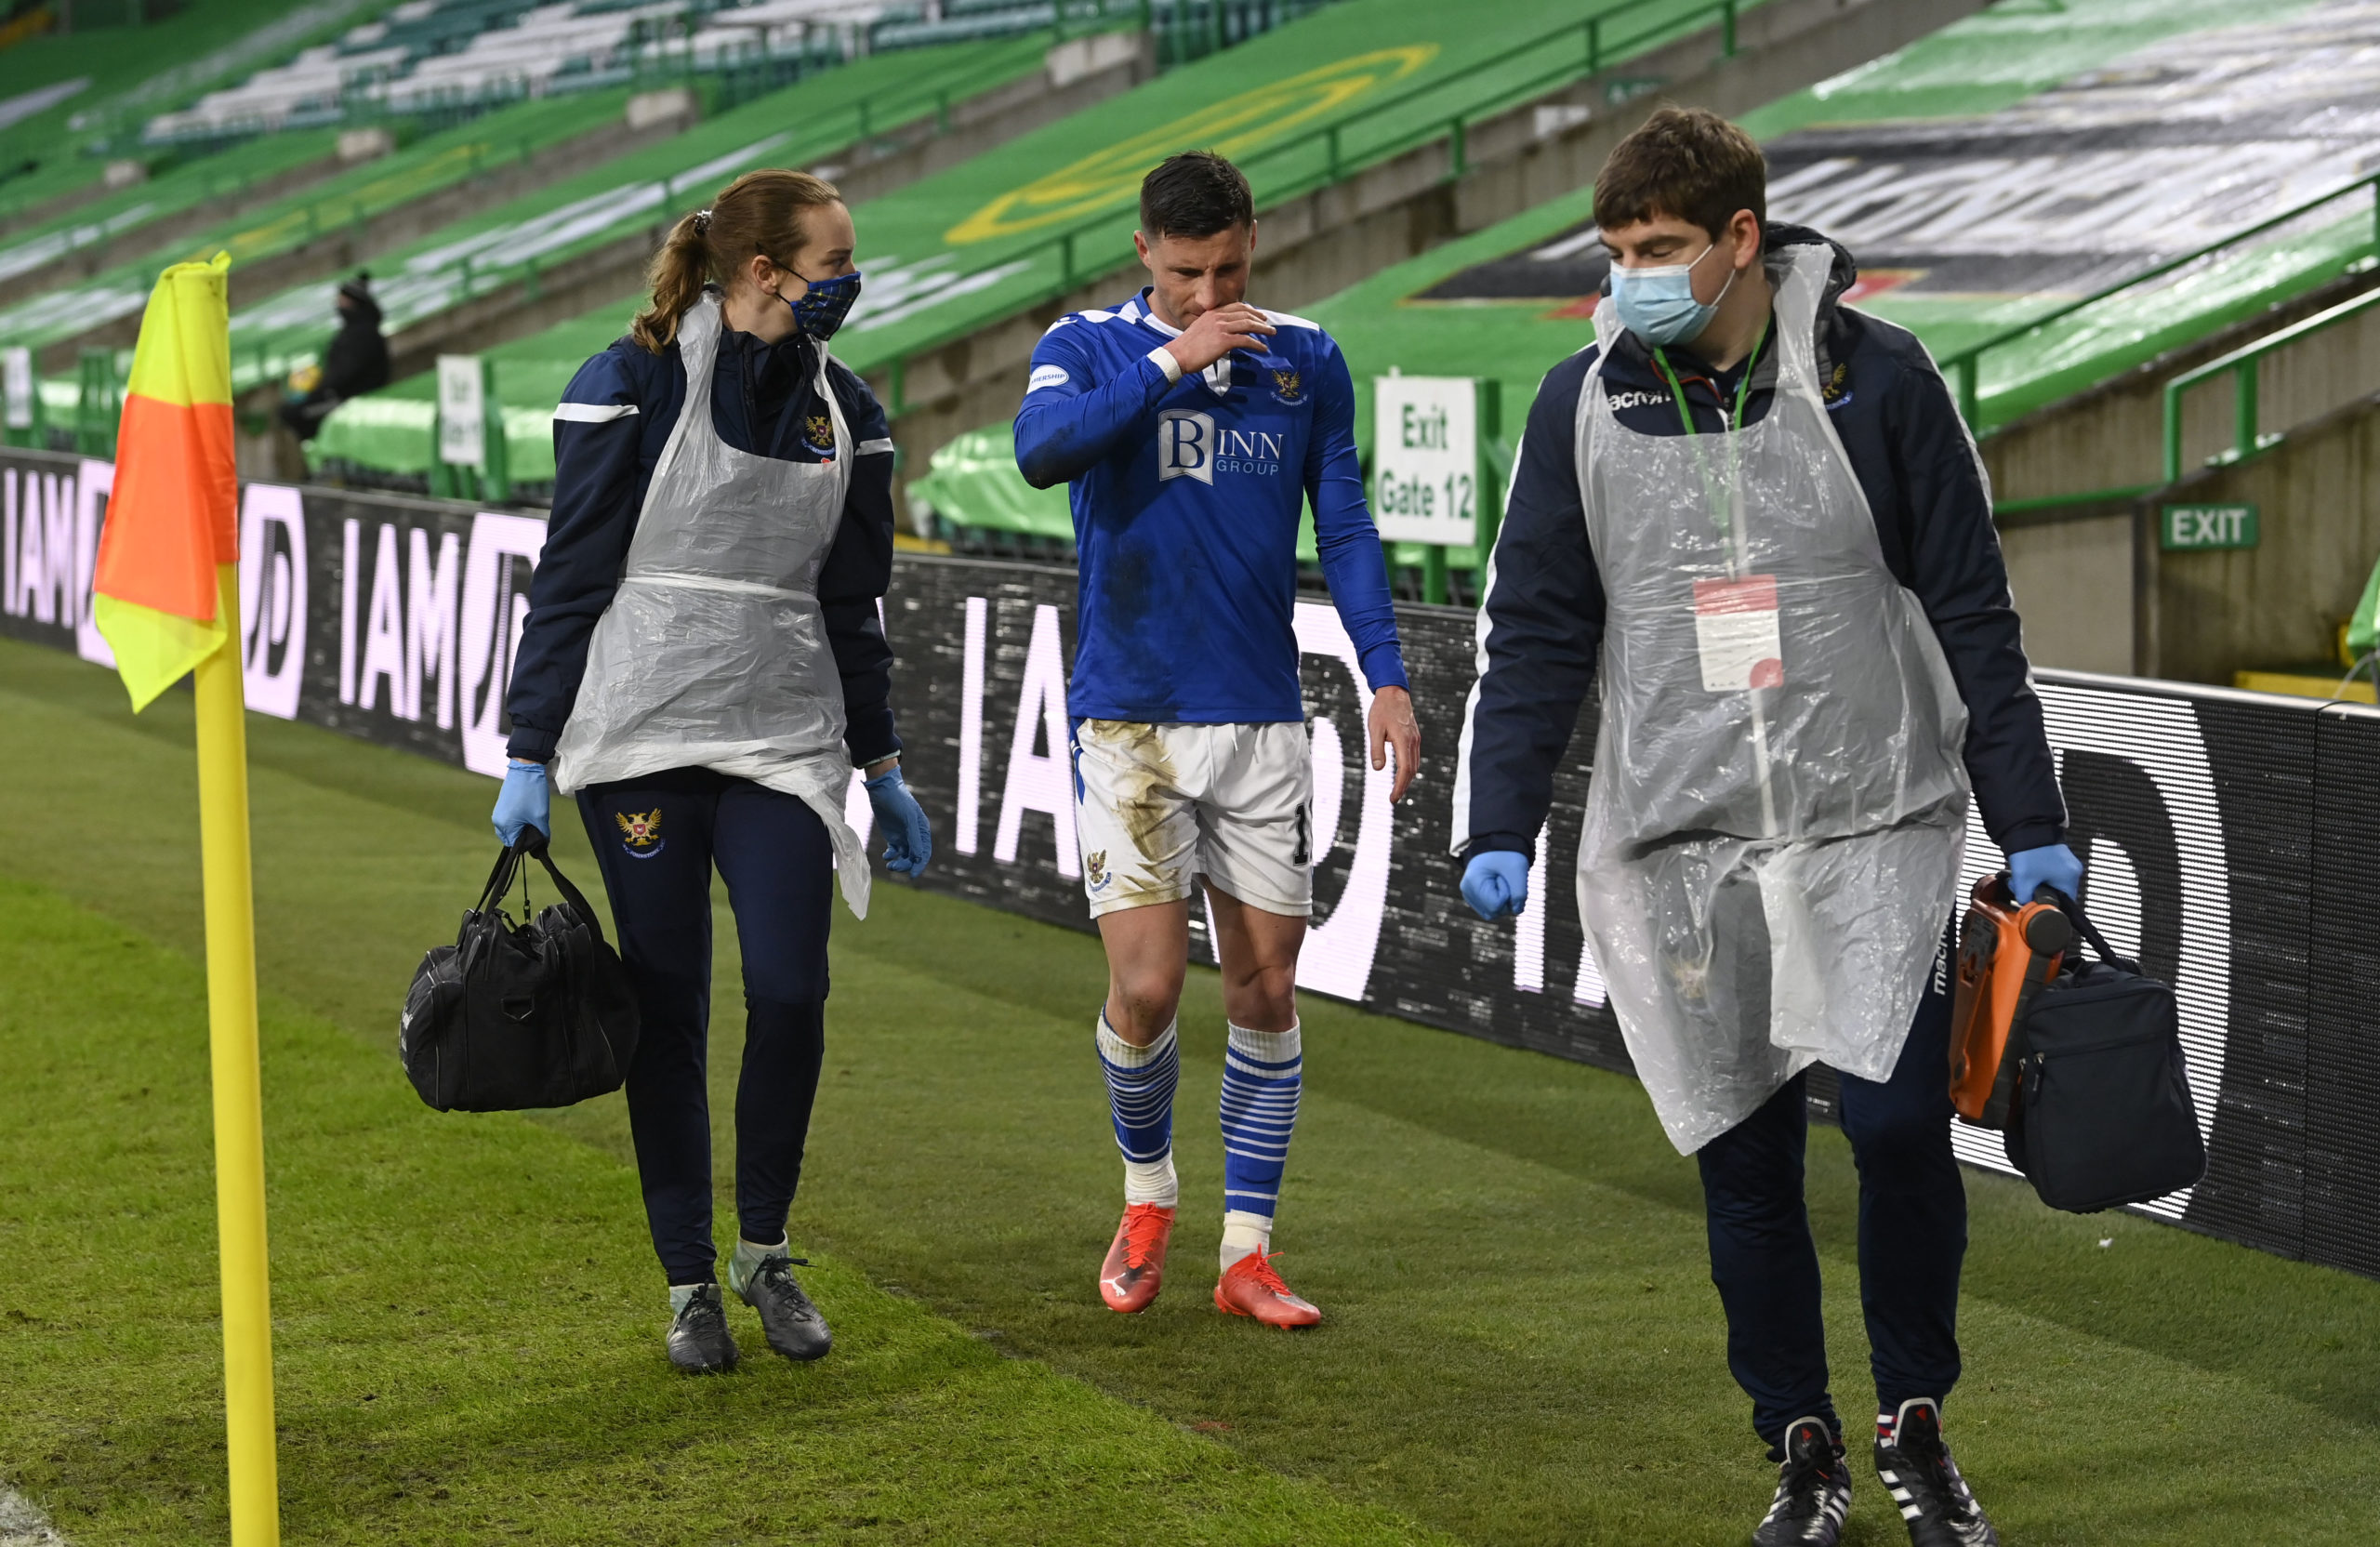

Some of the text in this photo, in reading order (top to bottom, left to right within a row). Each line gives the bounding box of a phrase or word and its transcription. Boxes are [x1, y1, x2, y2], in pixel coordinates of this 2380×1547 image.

[1402, 403, 1448, 450] Exit
[1216, 459, 1279, 476] GROUP
[1380, 469, 1473, 520] Gate 12
[2171, 509, 2248, 546] EXIT
